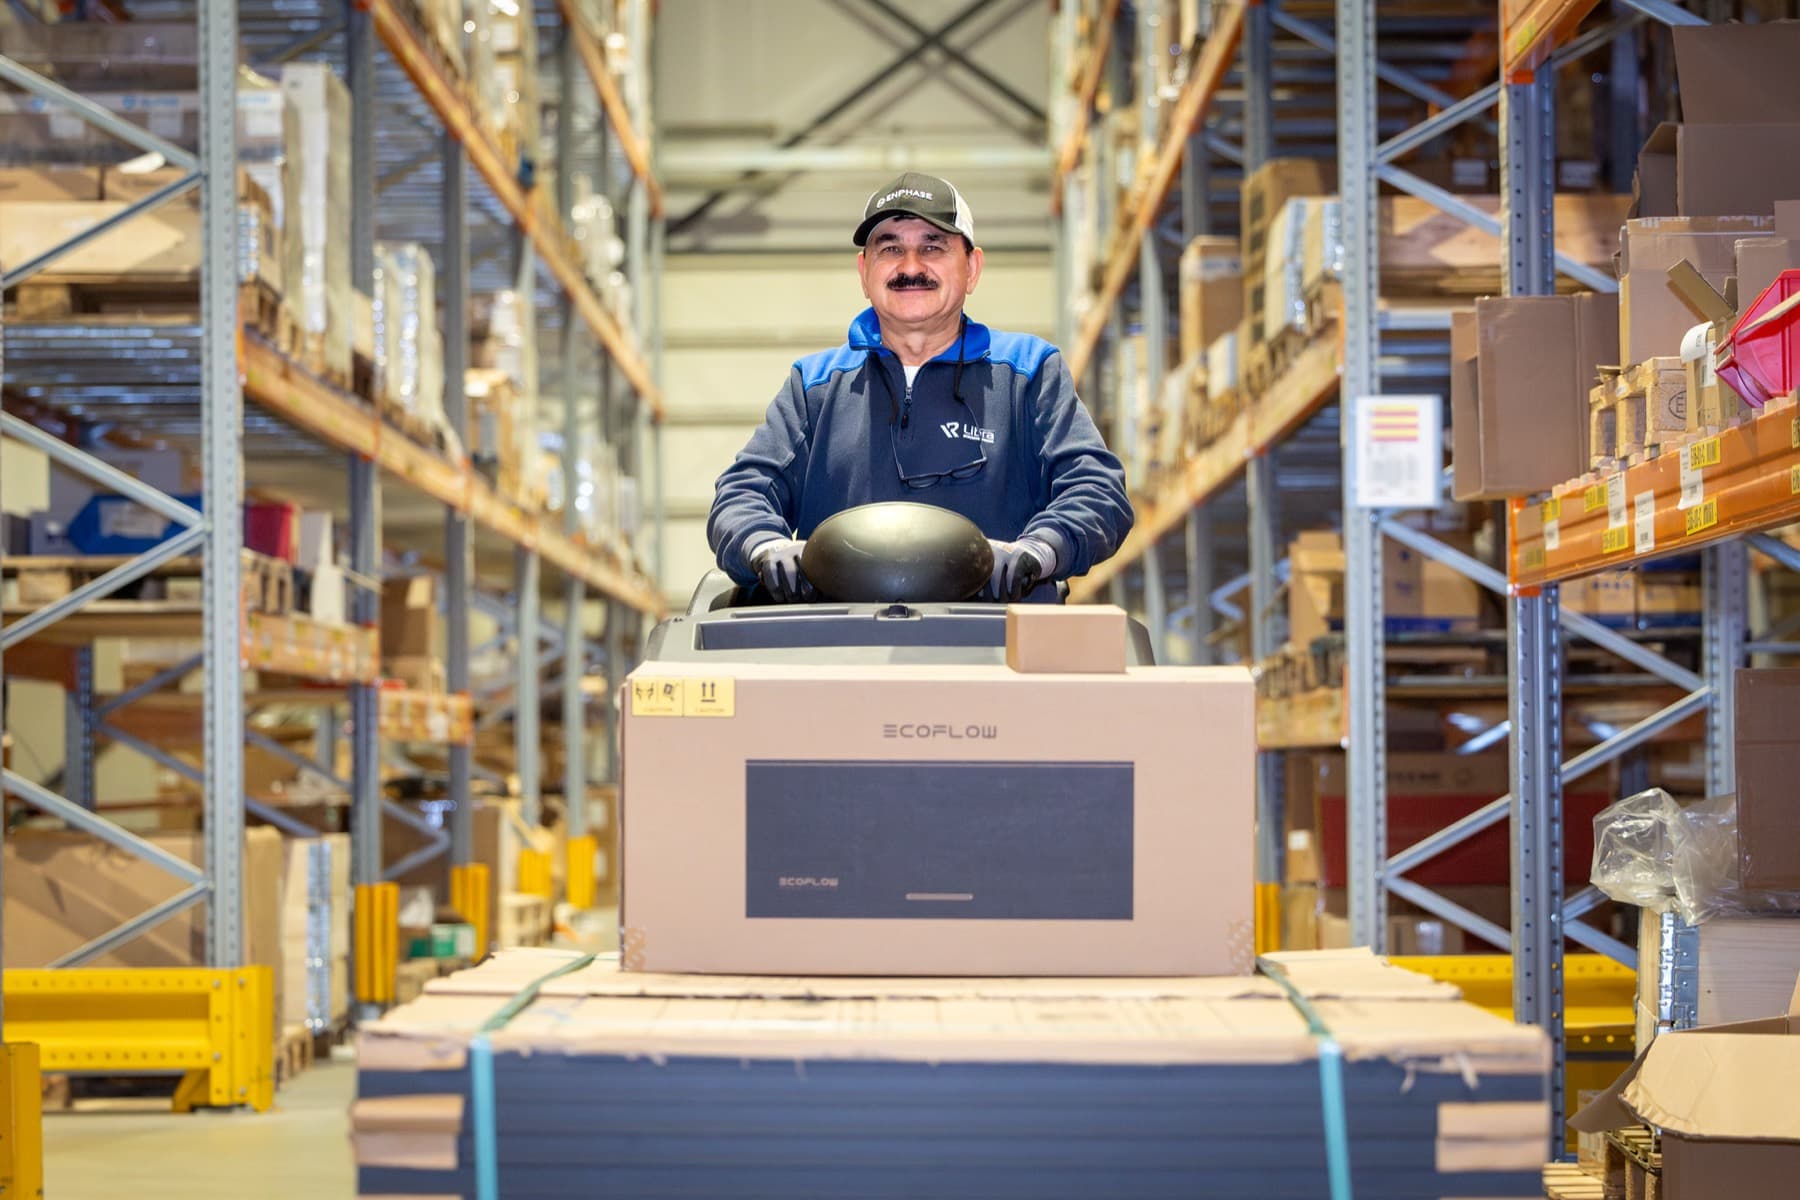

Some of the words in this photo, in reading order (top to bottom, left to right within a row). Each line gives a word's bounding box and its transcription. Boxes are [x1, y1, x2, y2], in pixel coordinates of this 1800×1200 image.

[886, 189, 933, 202] ENPHASE
[883, 724, 997, 739] ECOFLOW
[779, 877, 839, 887] ECOFLOW
